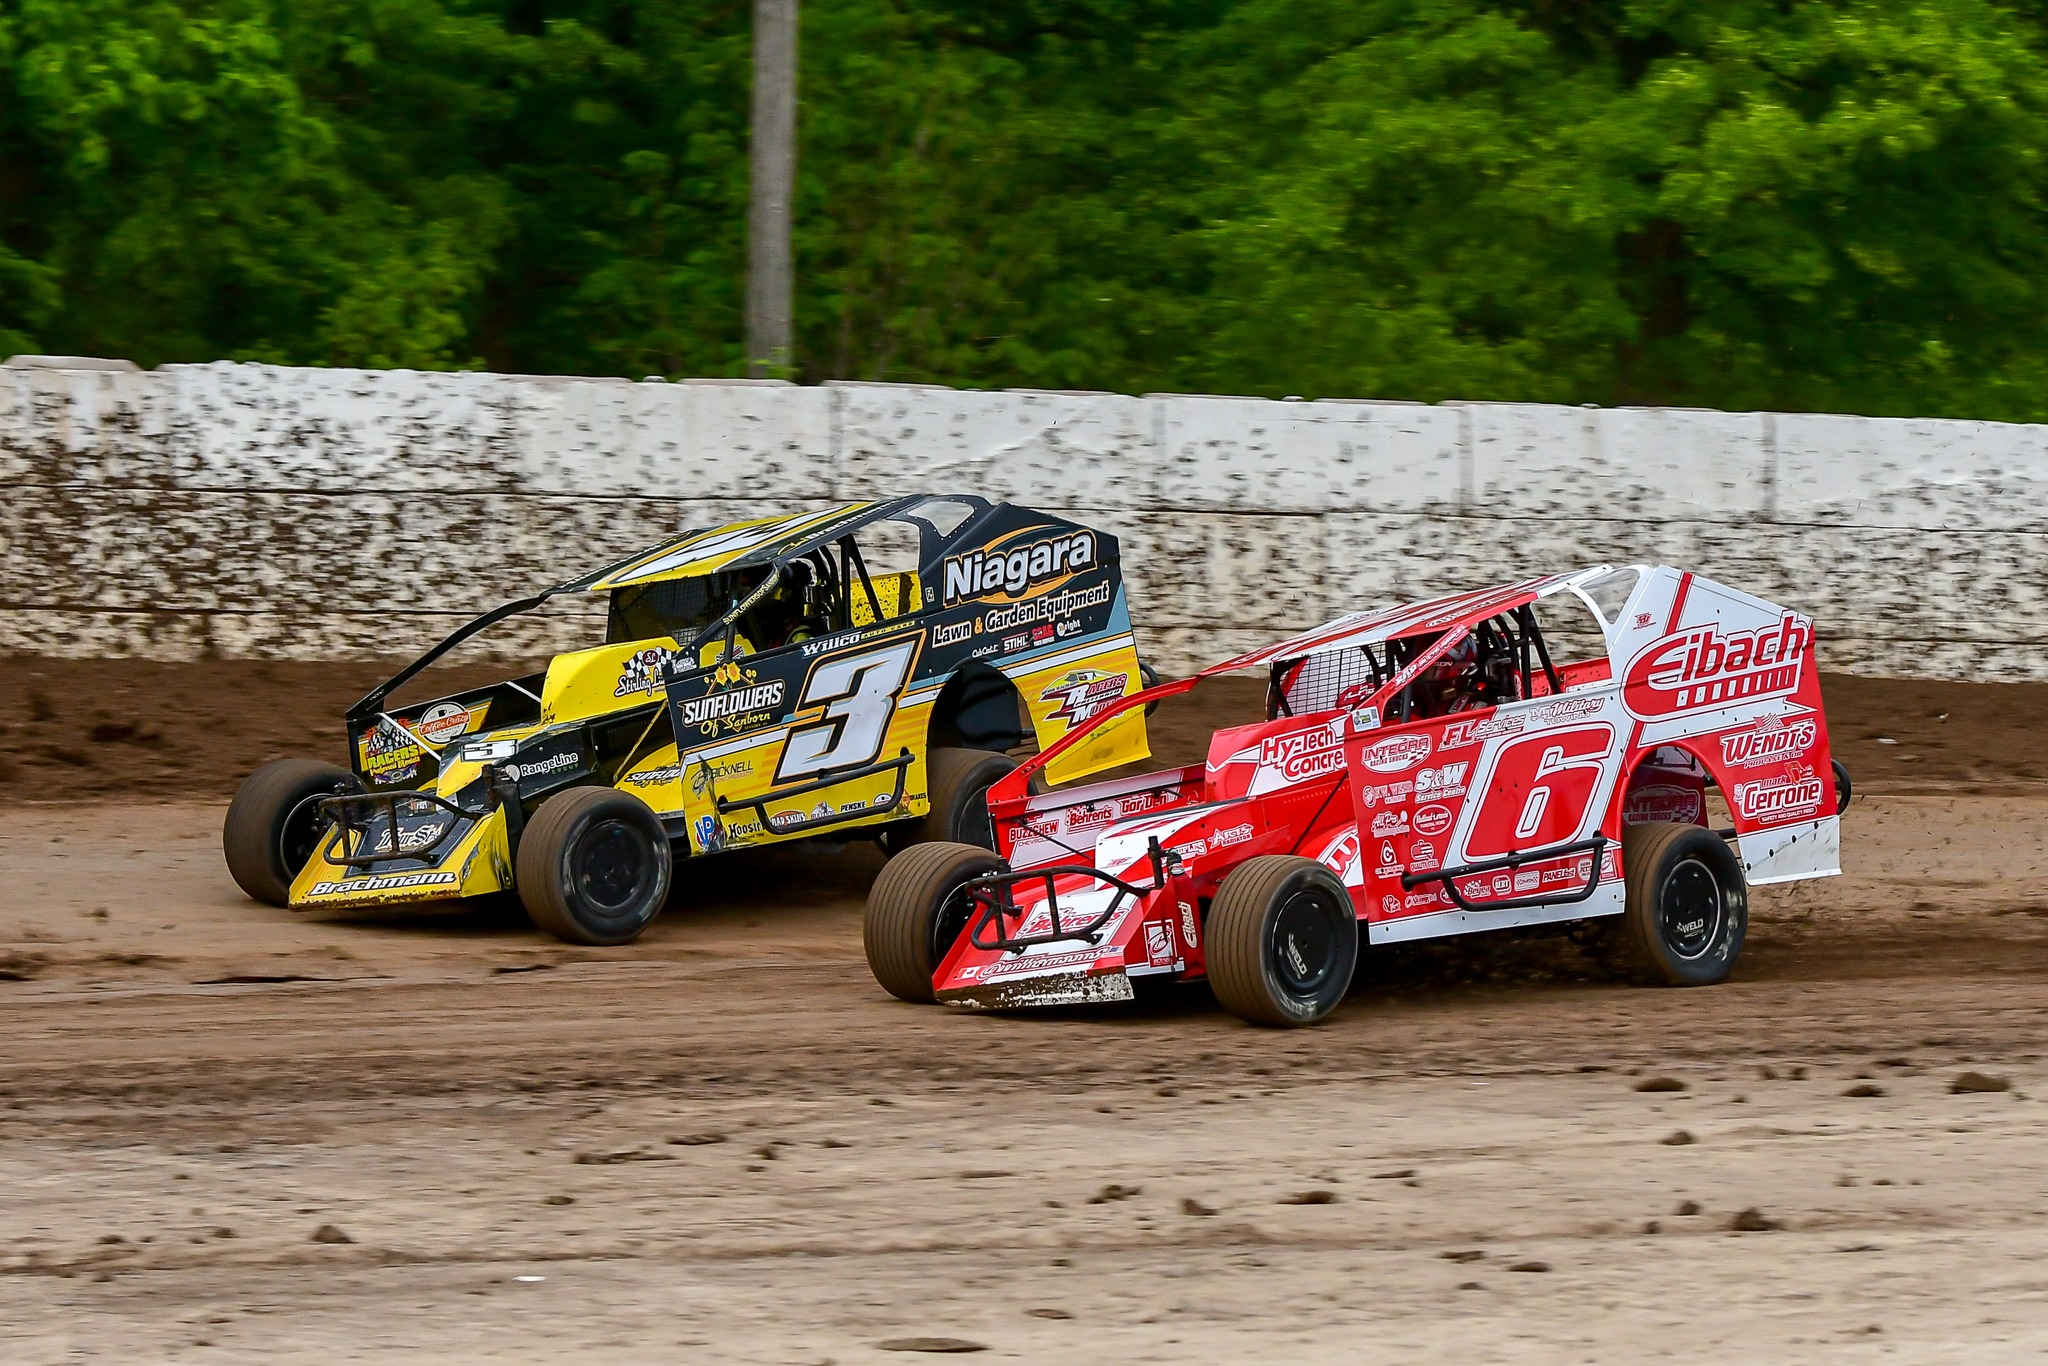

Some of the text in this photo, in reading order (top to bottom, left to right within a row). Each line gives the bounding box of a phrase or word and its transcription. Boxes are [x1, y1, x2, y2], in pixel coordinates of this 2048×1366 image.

[945, 533, 1094, 602] Niagara
[932, 580, 1110, 648] Lawn & Garden Equipment
[802, 630, 863, 658] Willco
[1003, 635, 1029, 651] STIHL
[1623, 613, 1808, 720] Eibach
[614, 675, 652, 697] Stirling
[1065, 674, 1126, 706] RACERS
[684, 682, 784, 724] SUNFLOWERS
[774, 636, 916, 784] 3
[1551, 698, 1606, 716] Military
[420, 721, 446, 735] Coffee
[446, 713, 470, 727] Crazy
[700, 719, 719, 738] Of
[723, 711, 771, 730] Sanborn
[1477, 713, 1526, 734] Services
[367, 744, 419, 769] RACERS
[1261, 727, 1335, 765] Hy-Tech
[1363, 737, 1430, 761] INTEGRA
[521, 752, 579, 777] RangeLine
[1416, 763, 1468, 792] S&W
[1460, 721, 1617, 863] 6
[1745, 782, 1820, 814] Cerrone
[840, 800, 867, 813] PENSKE
[1069, 806, 1113, 827] Behrents
[308, 871, 457, 896] Brachmann
[1681, 917, 1704, 934] WELD
